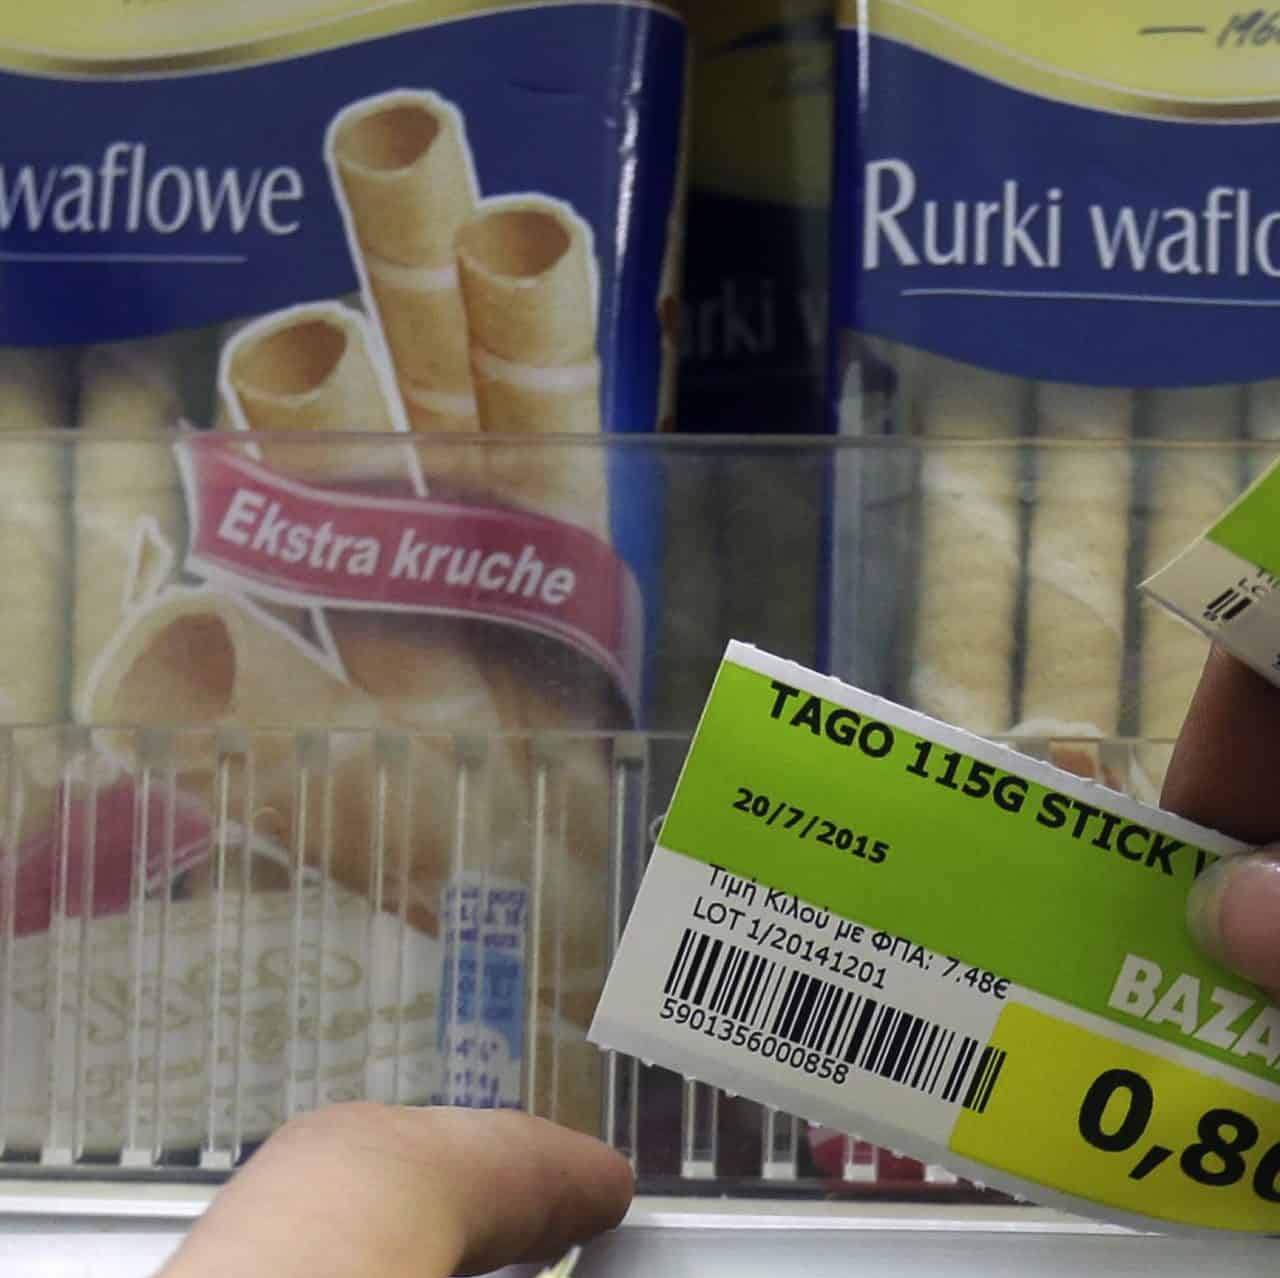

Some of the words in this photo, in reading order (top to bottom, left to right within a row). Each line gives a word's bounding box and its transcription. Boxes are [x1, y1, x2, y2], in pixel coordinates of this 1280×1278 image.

[0, 140, 305, 236] waflowe
[861, 157, 1064, 271] Rurki
[217, 488, 382, 576] Ekstra
[390, 527, 577, 604] kruche
[732, 787, 891, 865] 20/7/2015
[769, 681, 896, 759] TAGO
[905, 740, 1030, 814] 115G
[1036, 786, 1185, 875] STICK
[692, 896, 745, 932] LOT
[746, 918, 888, 989] 1/20141201
[707, 863, 757, 905] Τιμή
[764, 887, 832, 930] Κιλού
[833, 917, 865, 943] με
[871, 930, 934, 971] ΦΠΑ:
[941, 955, 1012, 1000] 7.48€
[658, 997, 850, 1086] 5901356000858
